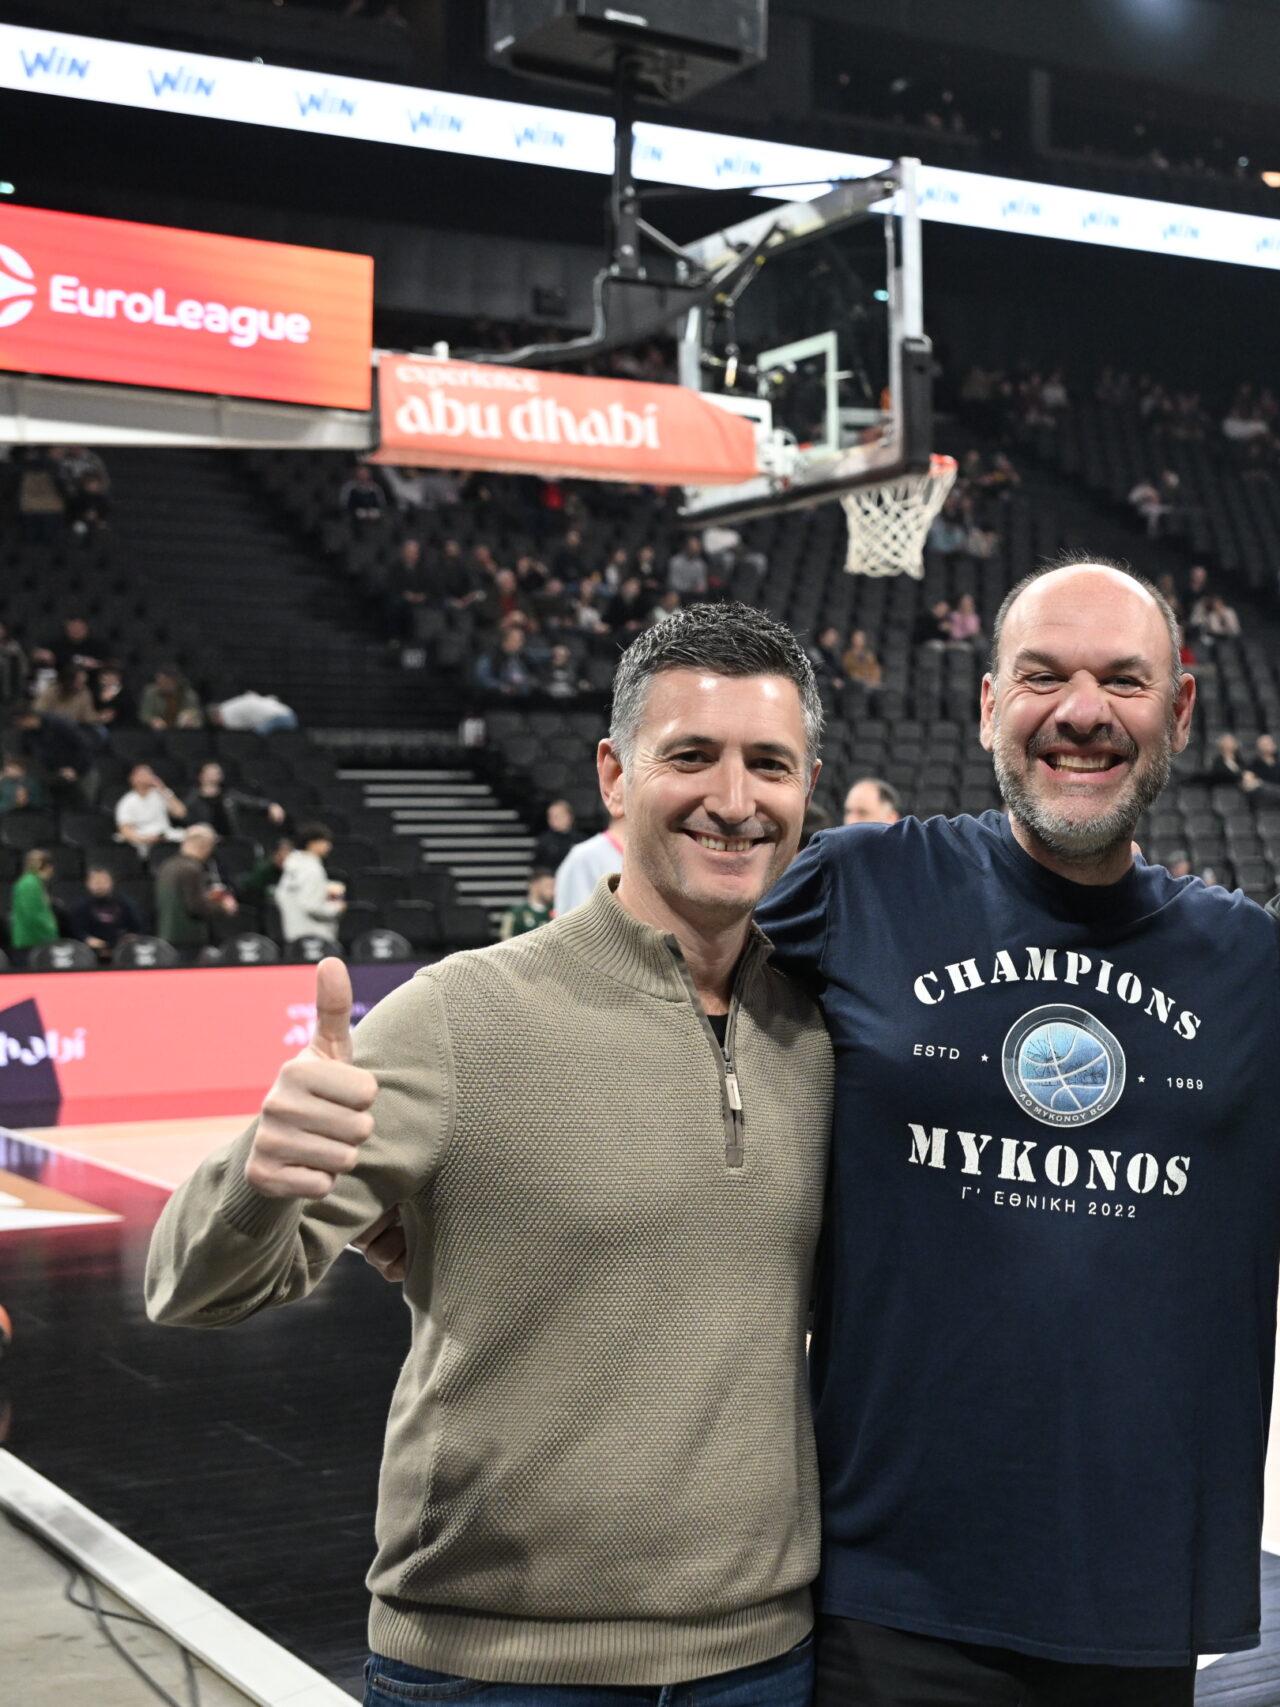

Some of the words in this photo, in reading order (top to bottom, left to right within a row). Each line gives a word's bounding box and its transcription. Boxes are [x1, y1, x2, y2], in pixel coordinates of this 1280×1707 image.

[50, 274, 311, 348] EuroLeague
[395, 388, 504, 440] abu
[508, 397, 661, 449] dhabi
[913, 946, 1202, 1040] CHAMPIONS
[913, 1044, 960, 1060] ESTD
[1166, 1077, 1204, 1090] 1989
[907, 1122, 1191, 1196] MYKONOS
[1087, 1202, 1137, 1218] 2022
